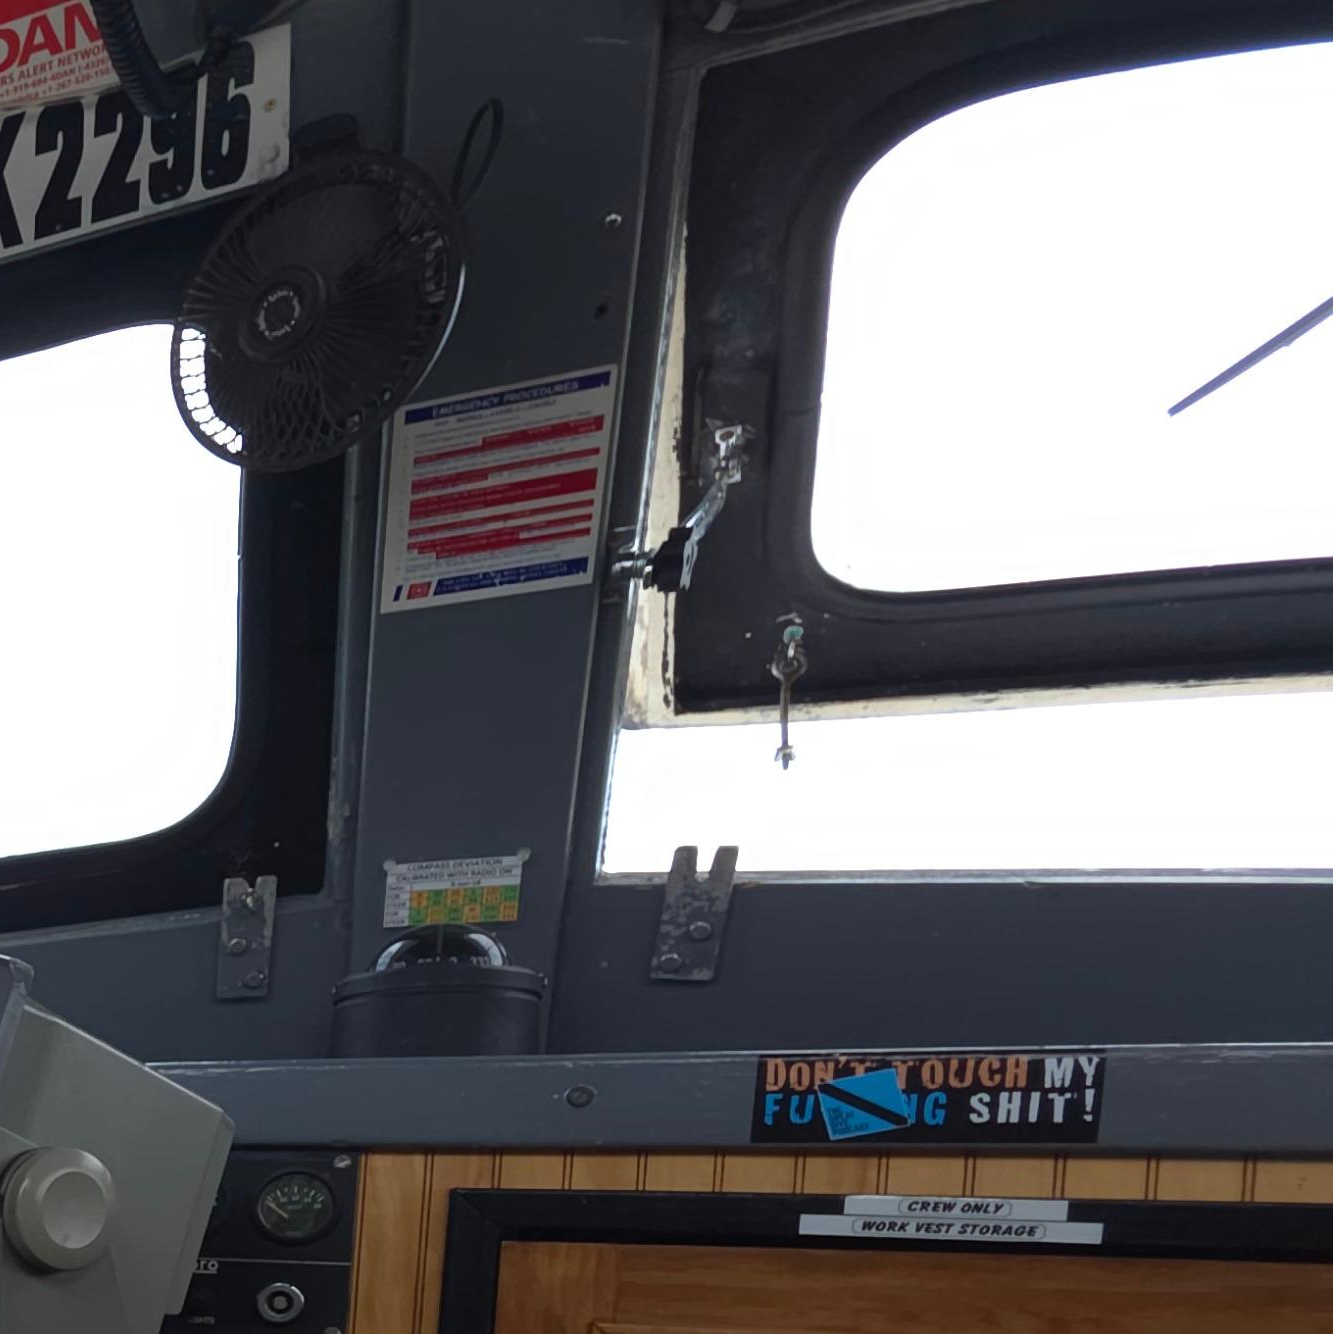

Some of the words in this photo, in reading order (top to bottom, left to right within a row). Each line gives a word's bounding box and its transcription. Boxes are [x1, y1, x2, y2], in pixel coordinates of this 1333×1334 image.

[18, 60, 53, 80] ALERT
[433, 395, 502, 418] EMERGENCY
[503, 381, 580, 403] PROCEDURES
[891, 1056, 1028, 1091] TOUCH
[1043, 1056, 1100, 1089] MY
[969, 1088, 1096, 1125] SHIT!
[907, 1200, 957, 1213] CREW
[961, 1201, 1004, 1215] ONLY
[860, 1219, 908, 1234] WORK
[915, 1221, 953, 1235] VEST
[957, 1223, 1039, 1238] STORAGE
